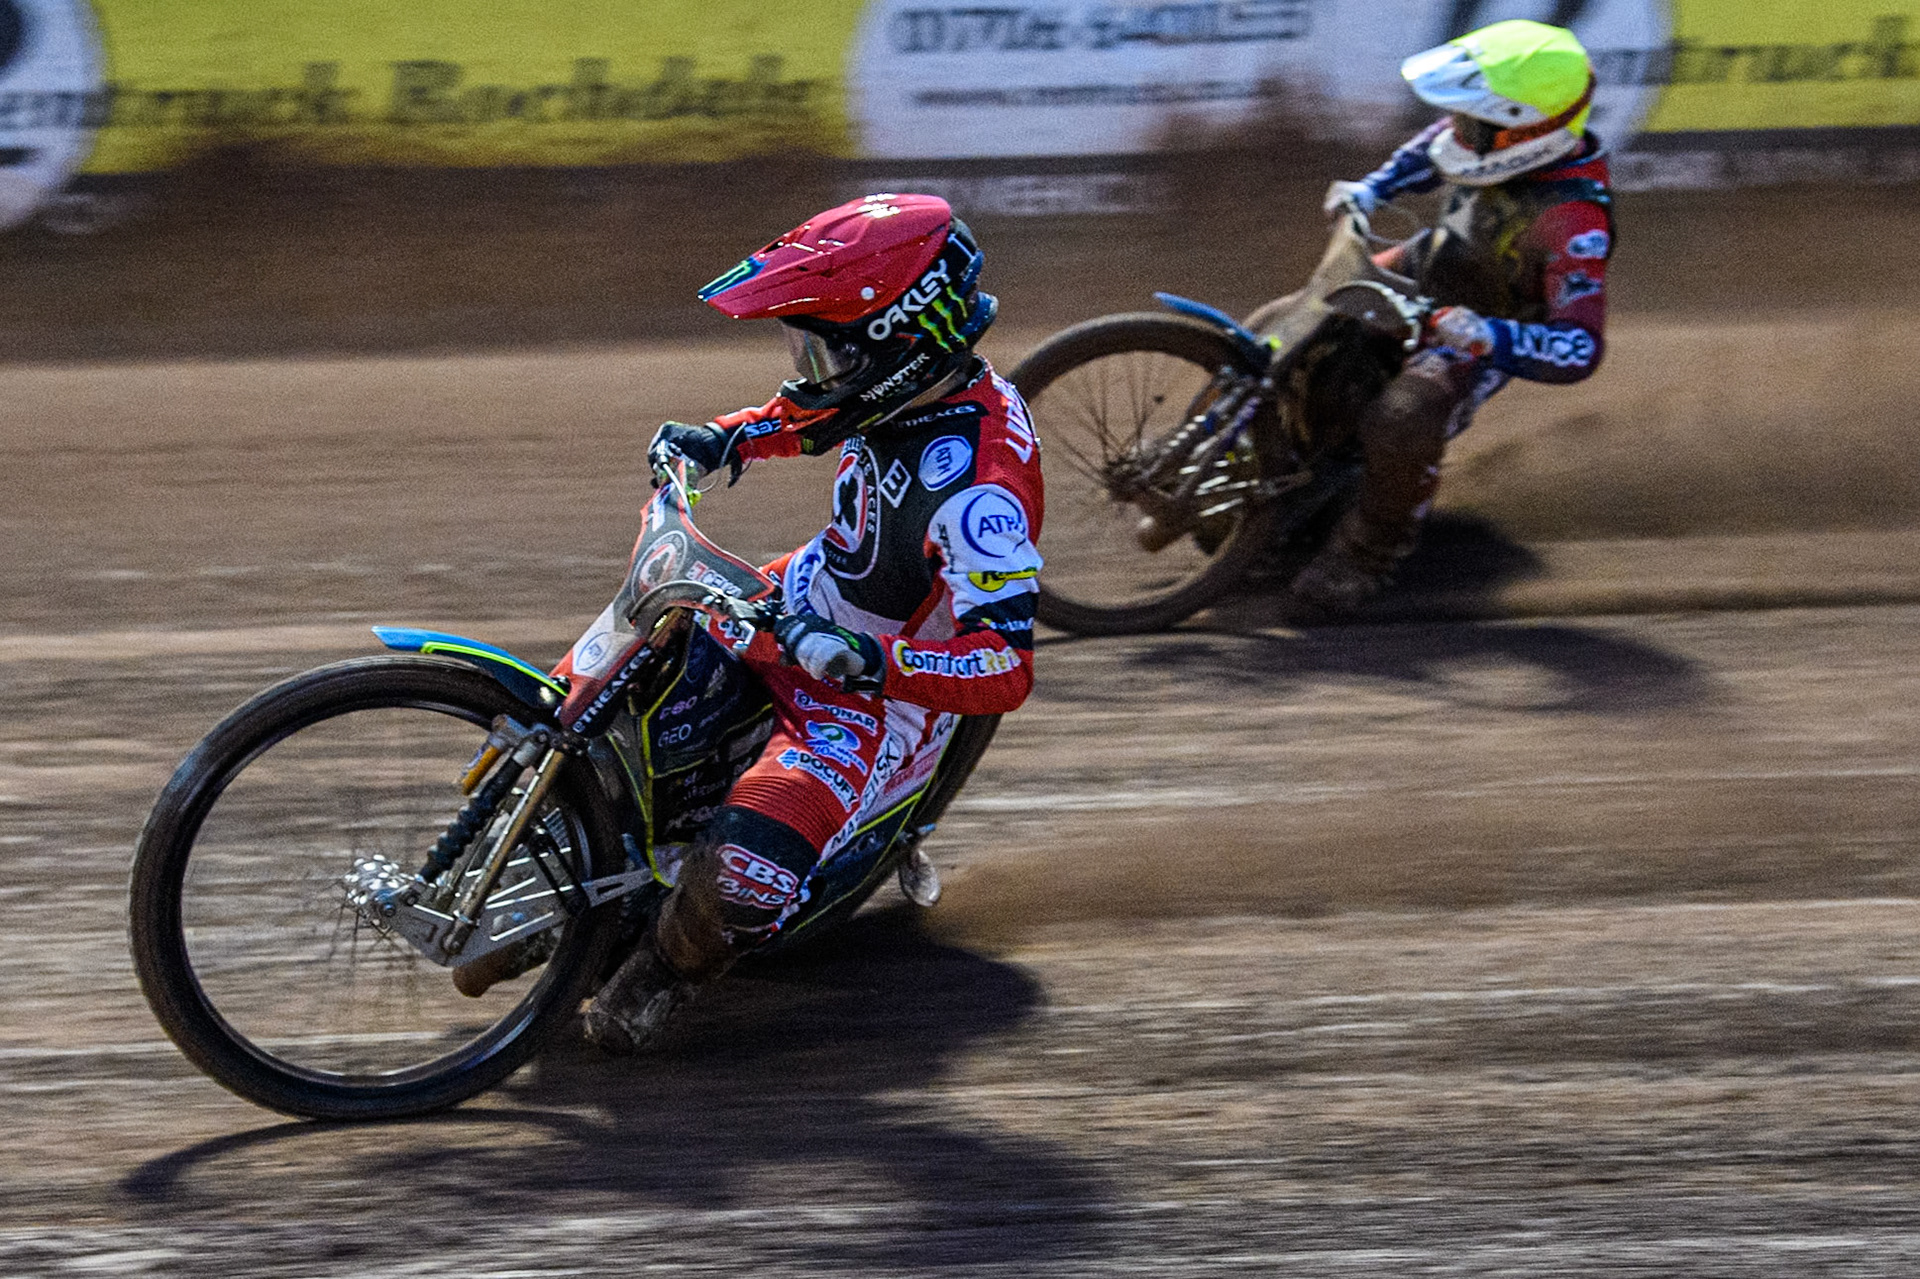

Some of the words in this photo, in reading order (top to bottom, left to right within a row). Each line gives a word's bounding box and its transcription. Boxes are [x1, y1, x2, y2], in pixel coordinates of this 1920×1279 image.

[867, 258, 951, 341] OAKLEY
[860, 352, 931, 402] MONSTER
[799, 752, 858, 803] DOCUFY
[720, 849, 795, 894] CBS
